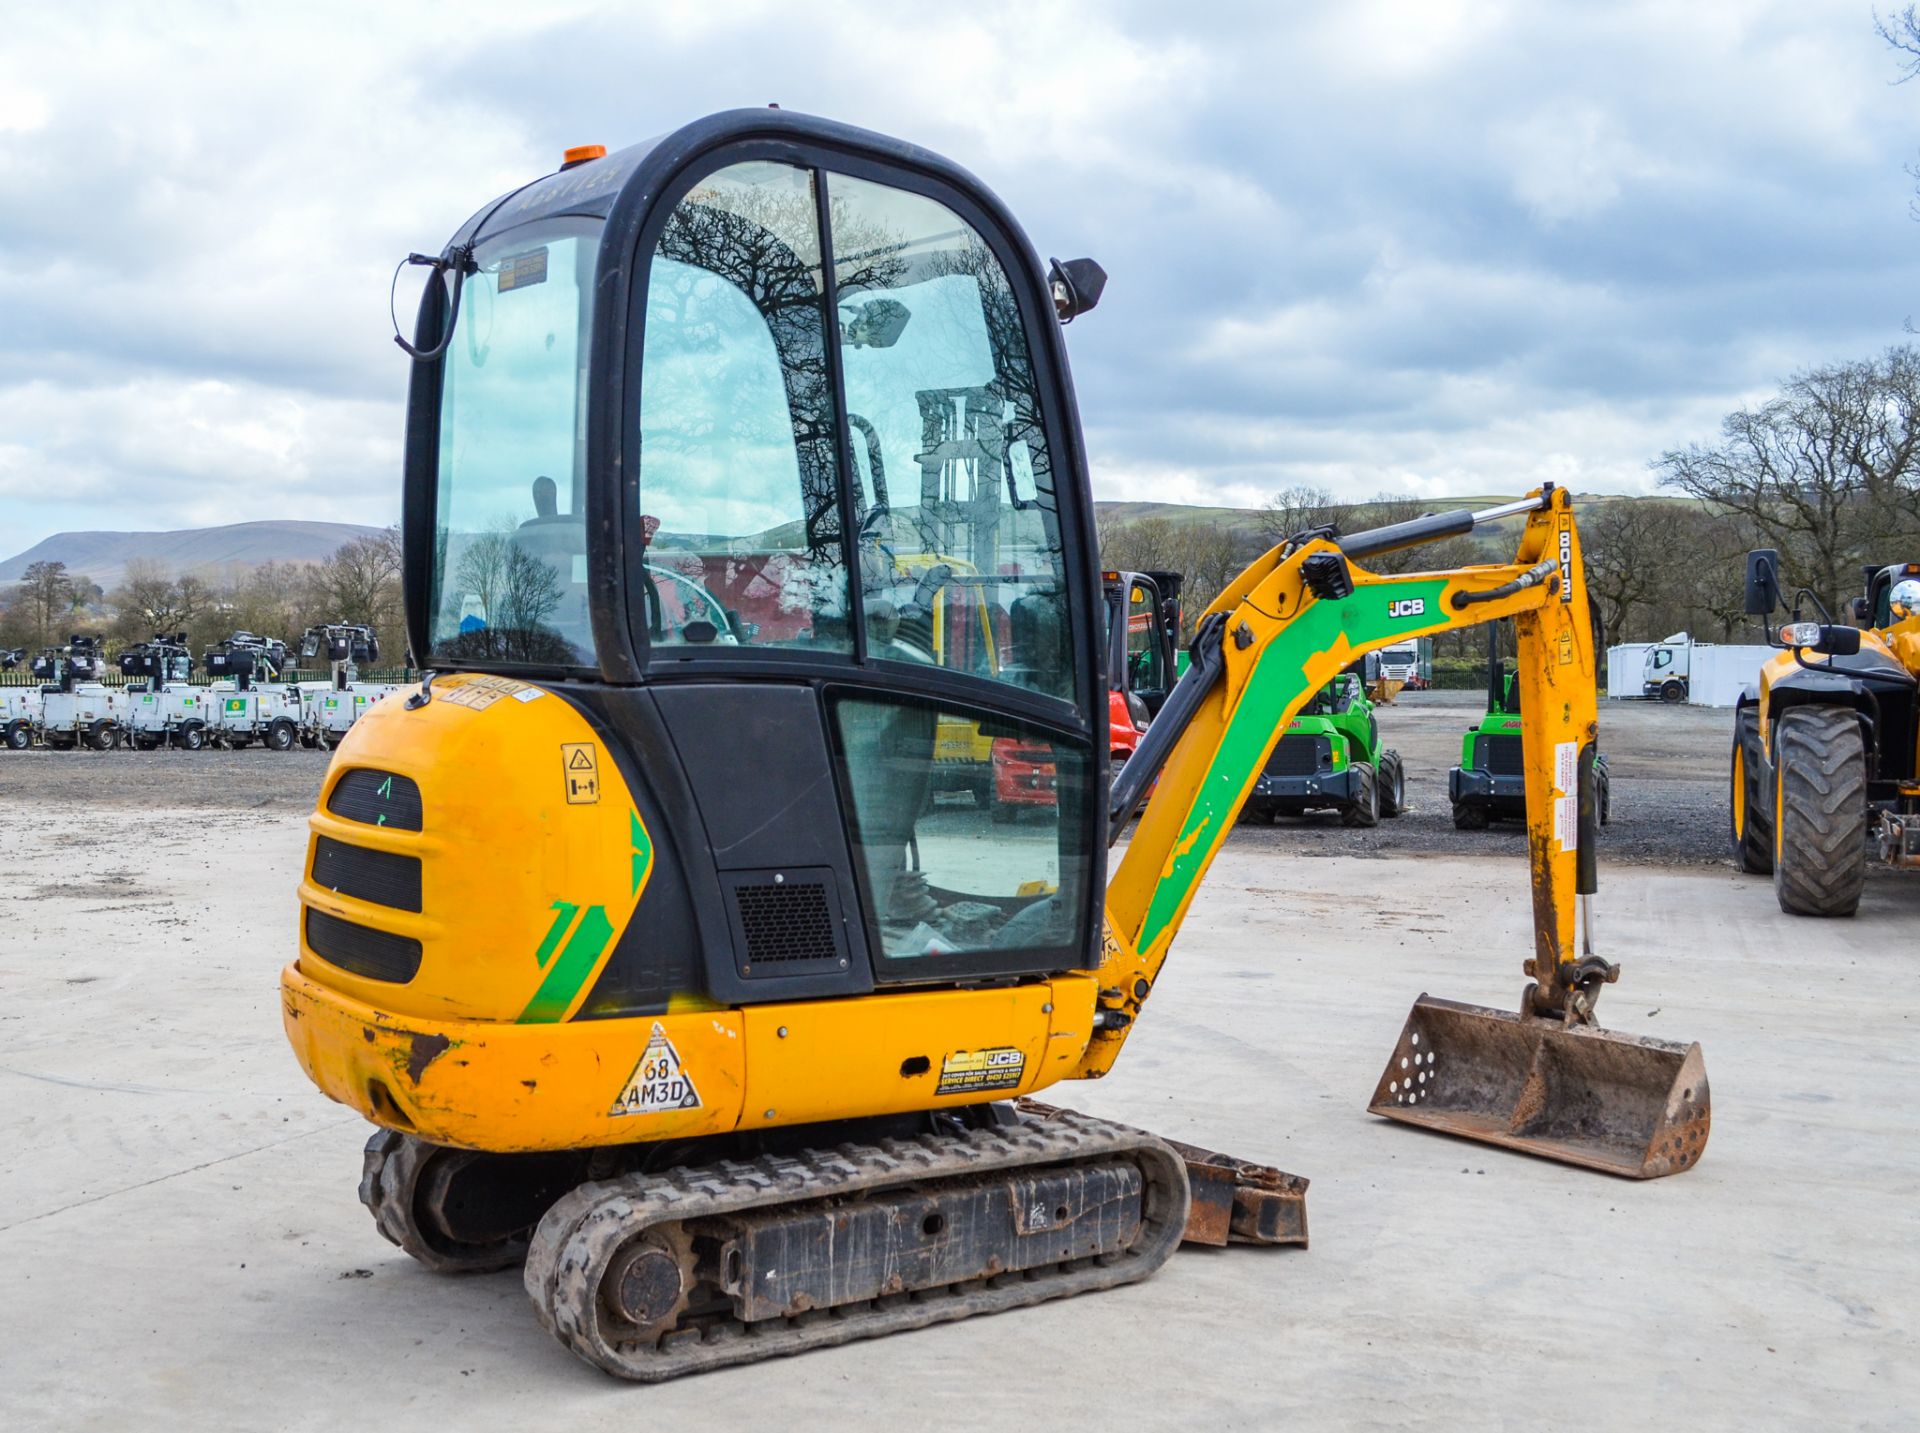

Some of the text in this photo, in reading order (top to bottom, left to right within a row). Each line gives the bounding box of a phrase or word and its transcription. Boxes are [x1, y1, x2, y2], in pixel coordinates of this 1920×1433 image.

[1559, 531, 1571, 594] 8013
[1388, 598, 1424, 617] JCB
[987, 1052, 1021, 1066] JCB
[645, 1059, 669, 1081] 68
[941, 1077, 963, 1086] SERVICE
[964, 1075, 984, 1083] DIRECT
[627, 1081, 684, 1106] AM3D
